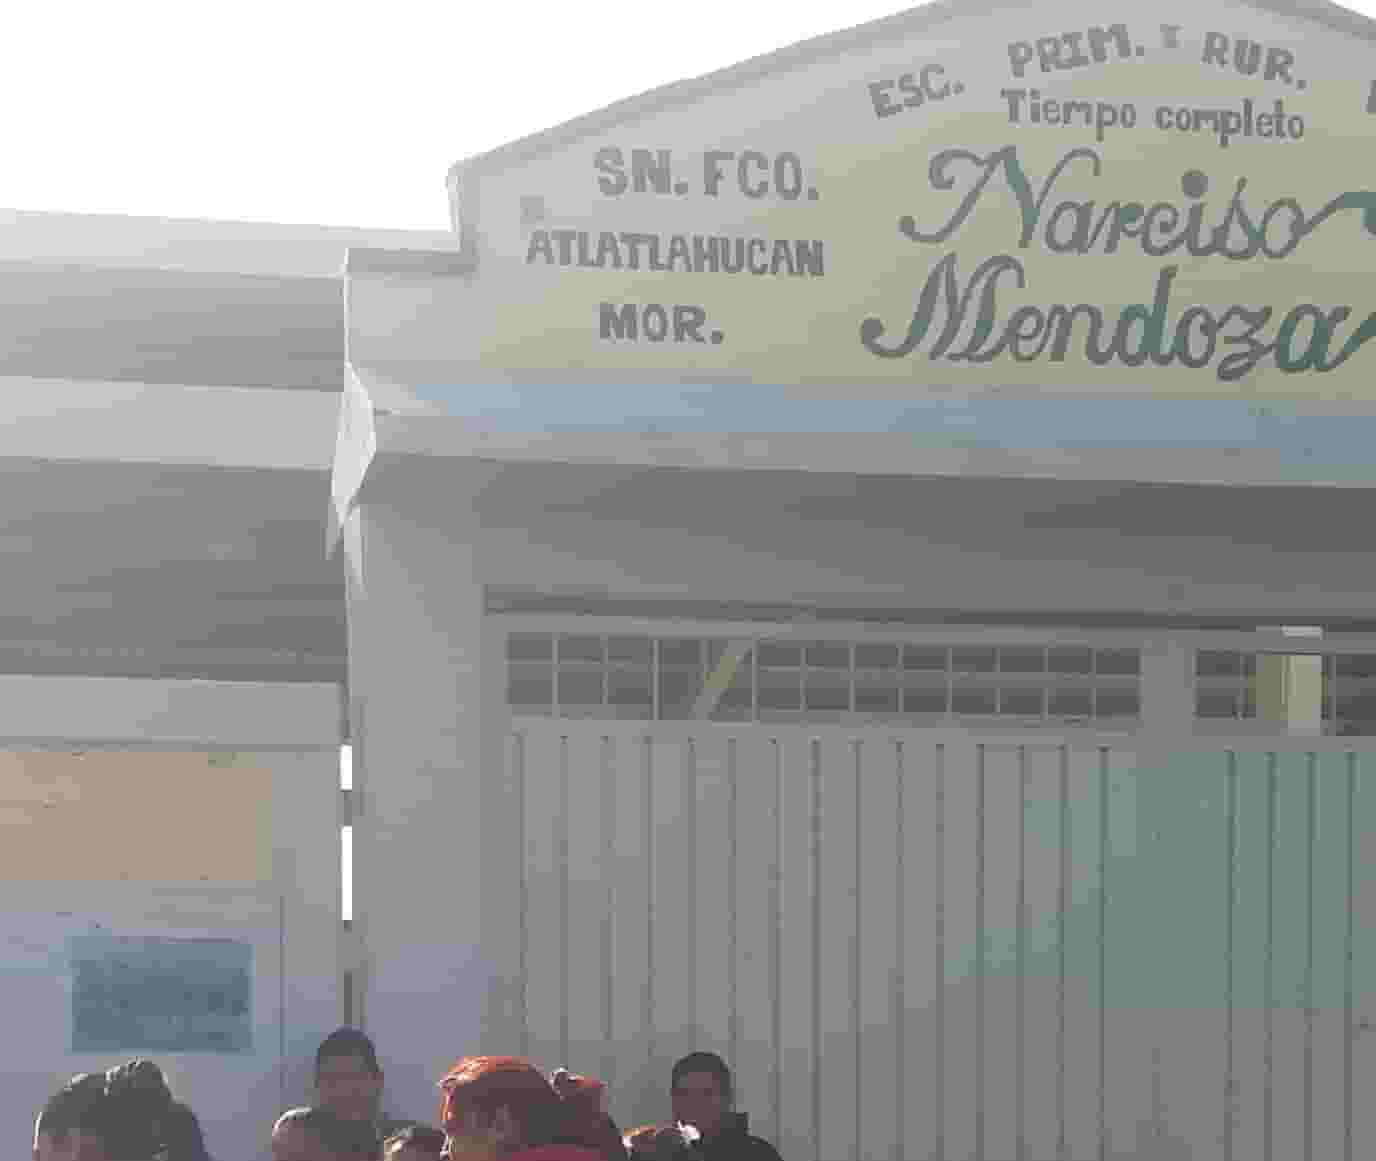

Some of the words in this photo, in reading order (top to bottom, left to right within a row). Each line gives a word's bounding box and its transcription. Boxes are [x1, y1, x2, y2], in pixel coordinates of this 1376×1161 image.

[868, 63, 965, 119] ESC.
[1006, 23, 1145, 79] PRIM.
[1200, 31, 1308, 90] RUR.
[1000, 87, 1137, 143] Tiempo
[1154, 97, 1305, 148] completo
[593, 146, 689, 197] SN.
[702, 150, 820, 201] FCO.
[525, 229, 825, 277] ATLATLAHUCAN
[598, 302, 725, 344] MOR.
